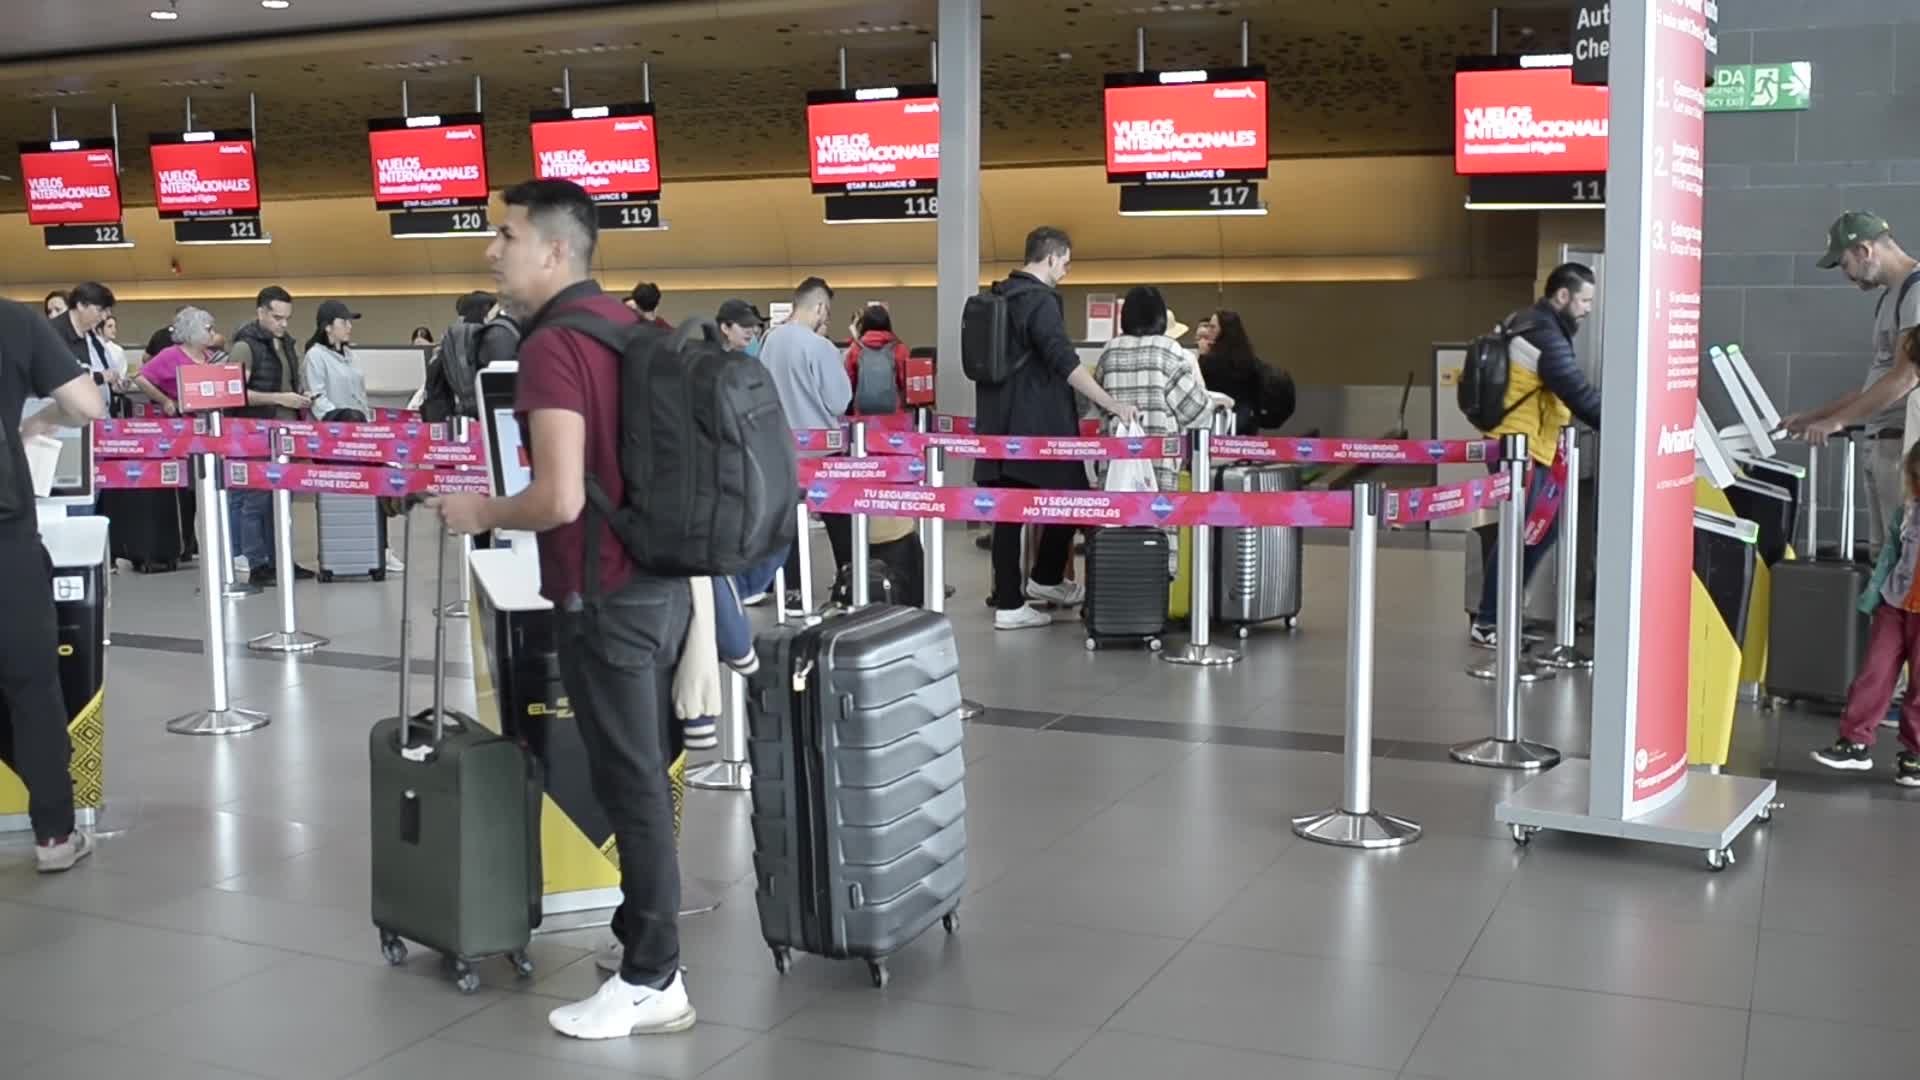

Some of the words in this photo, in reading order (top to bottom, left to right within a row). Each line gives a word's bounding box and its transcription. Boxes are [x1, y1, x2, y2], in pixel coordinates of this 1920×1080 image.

[1577, 8, 1610, 30] Aut
[1576, 38, 1609, 61] Che
[1717, 69, 1745, 86] DA
[1463, 106, 1533, 124] VUELOS
[1113, 119, 1174, 135] VUELOS
[815, 132, 870, 149] VUELOS
[1114, 130, 1257, 151] INTERNACIONALES
[377, 157, 420, 170] VUELOS
[539, 150, 587, 163] VUELOS
[159, 169, 198, 183] VUELOS
[378, 165, 479, 184] INTERNACIONALES
[541, 158, 650, 178] INTERNACIONALES
[1146, 171, 1169, 180] STAR
[1170, 170, 1214, 179] ALLIANCE
[28, 176, 65, 190] VUELOS
[160, 178, 251, 194] INTERNACIONALES
[846, 182, 867, 190] STAR
[868, 180, 907, 189] ALLIANCE
[1572, 180, 1607, 200] 11
[30, 185, 112, 200] INTERNACIONALES
[1209, 187, 1249, 206] 117
[903, 196, 939, 215] 118
[451, 213, 481, 230] 120
[620, 207, 652, 224] 119
[95, 227, 119, 241] 122
[230, 222, 256, 238] 121
[1657, 423, 1696, 456] Avianc
[815, 470, 828, 478] NO
[463, 484, 489, 493] ESCAL
[864, 488, 877, 498] TU
[878, 490, 936, 501] SEGURIDAD
[853, 499, 871, 508] NO
[871, 500, 899, 510] TIENE
[900, 501, 946, 512] ESCALAS
[1033, 496, 1047, 506] TU
[1048, 497, 1110, 508] SEGURIDAD
[1022, 507, 1040, 516] NO
[1041, 507, 1071, 518] TIENE
[1072, 508, 1121, 519] ESCALAS
